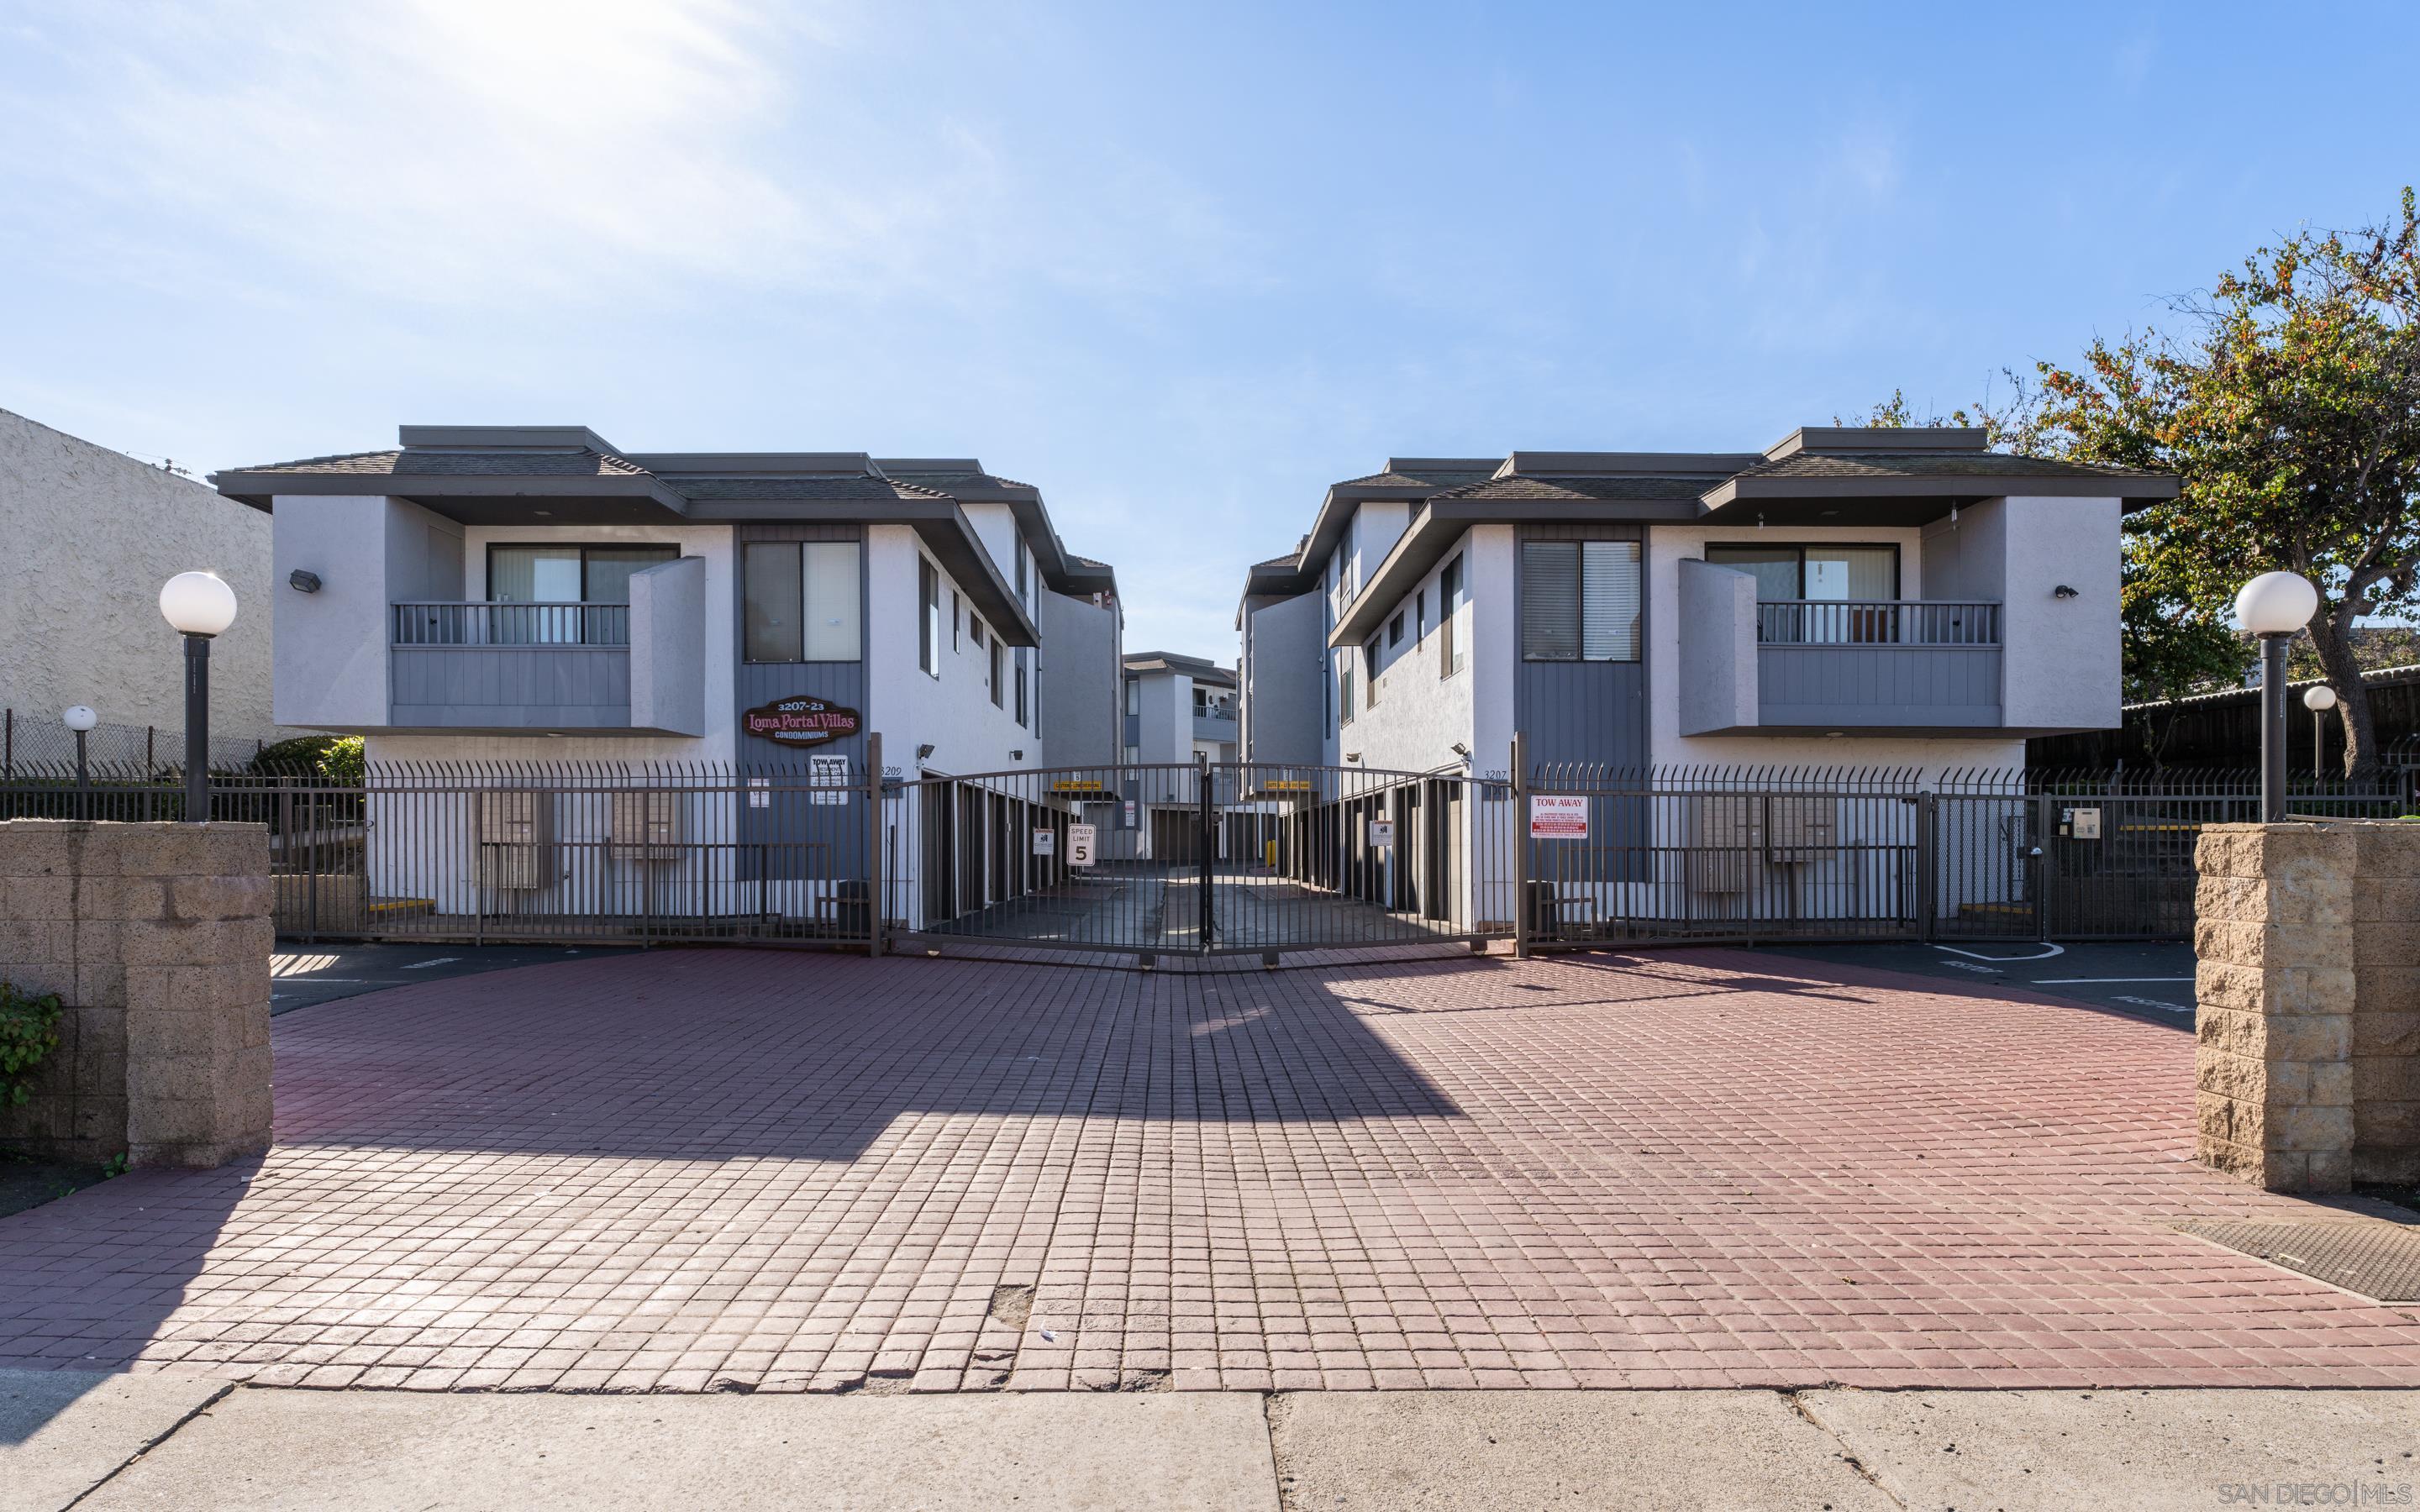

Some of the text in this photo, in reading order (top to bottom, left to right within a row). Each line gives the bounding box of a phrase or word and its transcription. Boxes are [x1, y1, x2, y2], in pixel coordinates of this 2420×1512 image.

[778, 701, 824, 711] 3207-23
[749, 713, 855, 732] Loma Portal Villas
[775, 731, 829, 739] CONDOMINIUMS
[1485, 769, 1507, 780] 3207
[1075, 846, 1087, 861] 5
